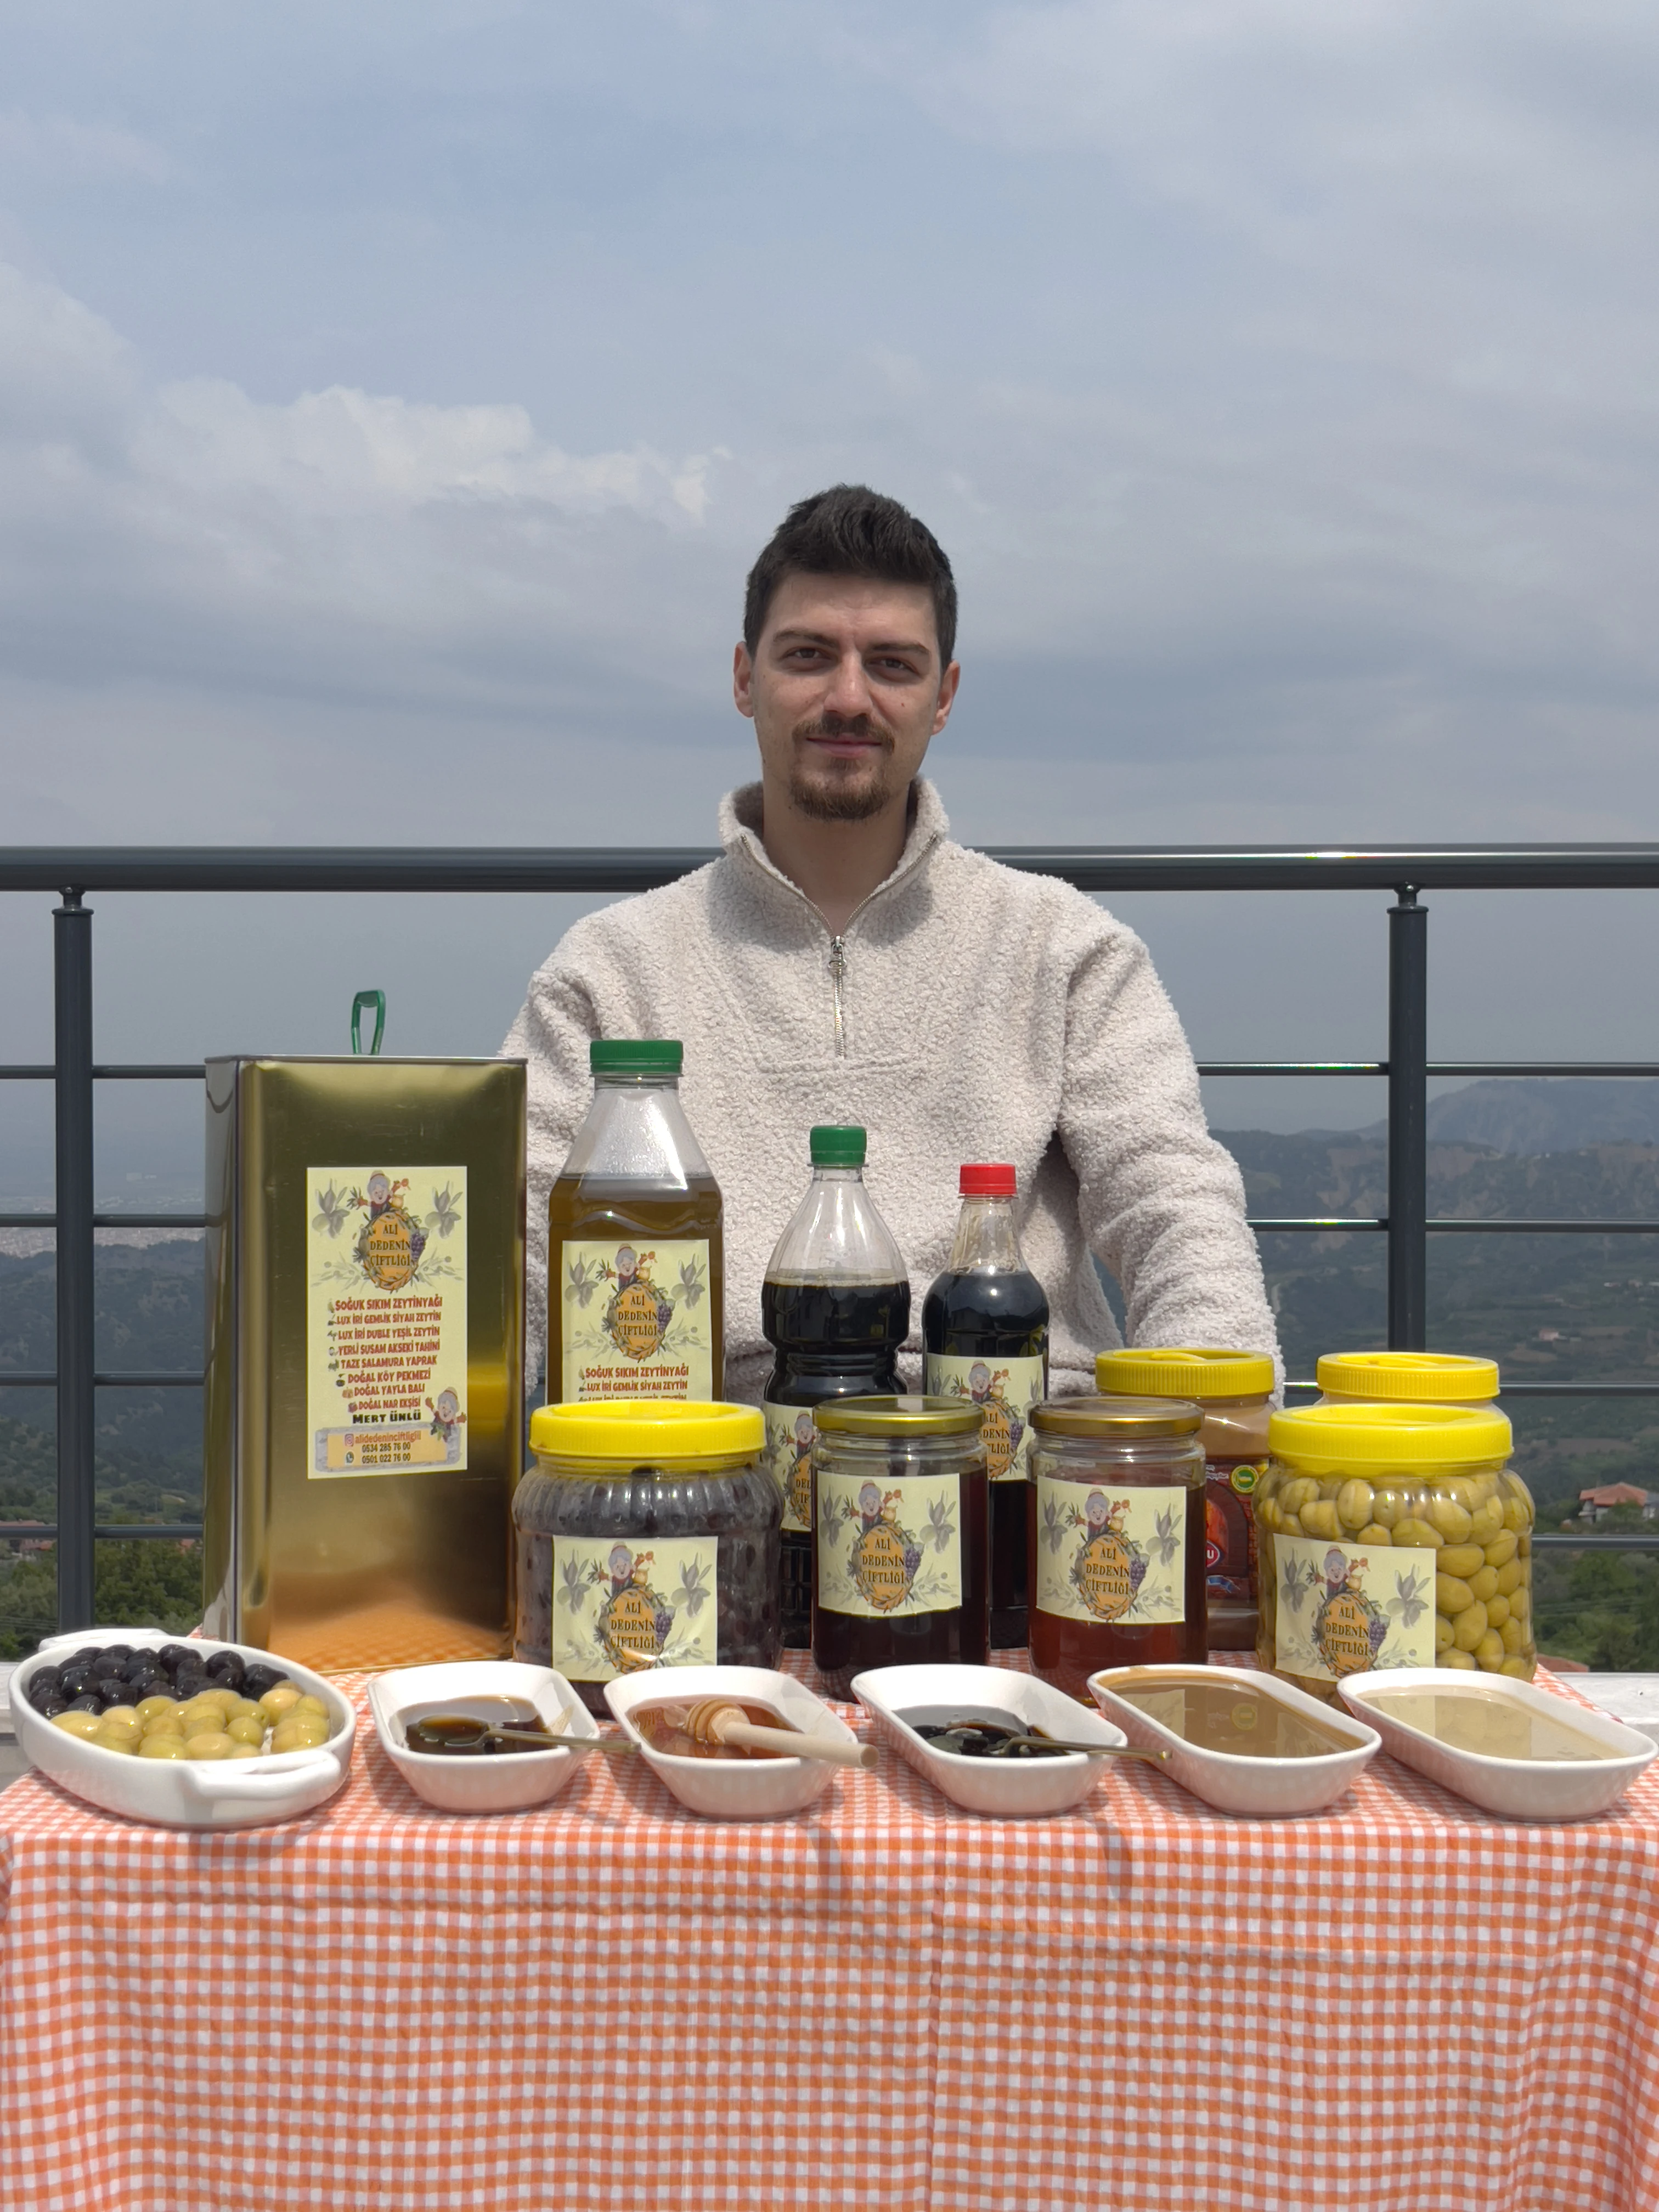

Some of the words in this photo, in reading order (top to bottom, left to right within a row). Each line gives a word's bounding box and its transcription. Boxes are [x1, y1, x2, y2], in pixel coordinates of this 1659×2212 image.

[383, 1223, 398, 1235] ALİ
[370, 1239, 411, 1250] DEDENİN
[370, 1254, 411, 1267] ÇİFTLİĞİ
[335, 1297, 365, 1311] SOĞUK
[366, 1298, 391, 1310] SIKIM
[392, 1294, 443, 1309] ZEYTİNYAĞI
[631, 1295, 645, 1306] ALİ
[337, 1316, 351, 1325] LUX
[353, 1312, 363, 1325] İRİ
[364, 1312, 391, 1324] GEMLİK
[393, 1311, 414, 1323] SİYAH
[416, 1310, 441, 1322] ZEYTİN
[618, 1310, 657, 1321] DEDENİN
[338, 1330, 353, 1340] LUX
[354, 1327, 365, 1340] İRİ
[392, 1325, 413, 1340] YEŞİL
[414, 1324, 440, 1337] ZEYTİN
[618, 1323, 658, 1336] ÇİFTLİĞİ
[338, 1342, 359, 1356] YERLİ
[360, 1343, 386, 1354] SUSAM
[388, 1340, 414, 1353] AKSEKİ
[341, 1358, 360, 1369] TAZE
[362, 1356, 404, 1368] SALAMURA
[406, 1355, 438, 1367] YAPRAK
[348, 1370, 376, 1384] DOĞAL
[377, 1370, 394, 1383] KÖY
[396, 1367, 431, 1381] PEKMEZİ
[586, 1365, 614, 1378] SOĞUK
[616, 1367, 639, 1378] SIKIM
[640, 1363, 689, 1377] ZEYTİNYAĞI
[354, 1384, 380, 1396] DOĞAL
[382, 1385, 407, 1395] YAYLA
[408, 1383, 425, 1393] BALI
[587, 1383, 600, 1392] LUX
[602, 1380, 611, 1391] İRİ
[613, 1380, 639, 1391] GEMLİK
[640, 1379, 662, 1391] SİYAH
[663, 1378, 688, 1390] ZEYTİN
[359, 1398, 381, 1410] DOĞAL
[353, 1414, 387, 1424] MERT
[390, 1409, 421, 1422] ÜNLÜ
[982, 1427, 1009, 1439] DENİN
[362, 1443, 378, 1453] 0534
[380, 1443, 392, 1452] 285
[393, 1442, 401, 1451] 76
[403, 1442, 411, 1450] 00
[362, 1455, 378, 1464] 0501
[380, 1454, 392, 1463] 022
[393, 1453, 401, 1462] 76
[403, 1453, 411, 1462] 00
[874, 1537, 891, 1551] ALİ
[862, 1553, 905, 1567] DEDENİN
[1100, 1547, 1117, 1560] ALİ
[862, 1570, 904, 1584] ÇİFTLİĞİ
[1086, 1563, 1130, 1578] DEDENİN
[1086, 1578, 1129, 1595] ÇİFTLİĞİ
[625, 1600, 641, 1614] ALİ
[1339, 1606, 1355, 1620] ALİ
[611, 1617, 656, 1632] DEDENİN
[1326, 1622, 1369, 1638] DEDENİN
[610, 1634, 654, 1649] ÇİFTLİĞİ
[1326, 1637, 1369, 1656] ÇİFTLİĞİ
